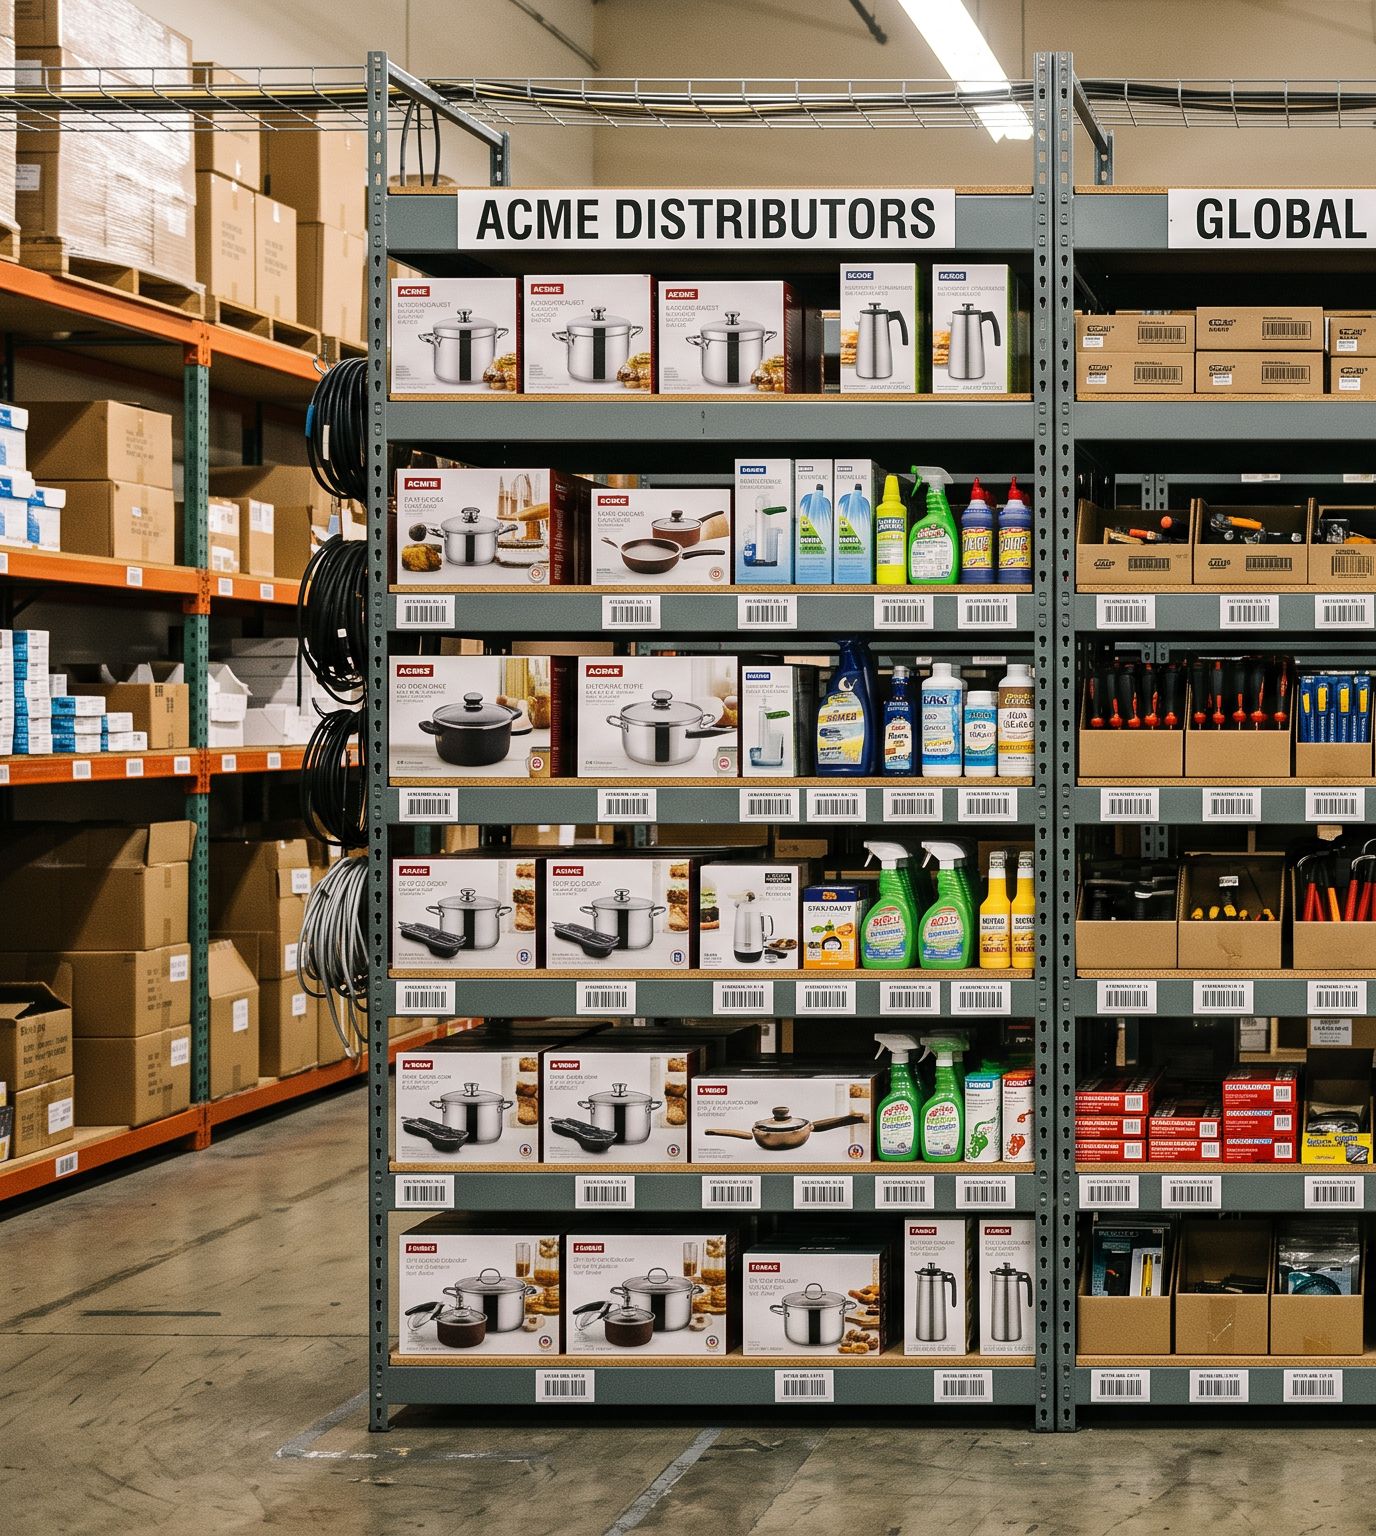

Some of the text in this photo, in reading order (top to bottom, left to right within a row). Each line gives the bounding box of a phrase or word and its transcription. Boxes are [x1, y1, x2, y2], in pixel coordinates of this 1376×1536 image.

[477, 198, 936, 240] ACME DISTRIBUTORS
[1196, 198, 1366, 240] GLOBAL
